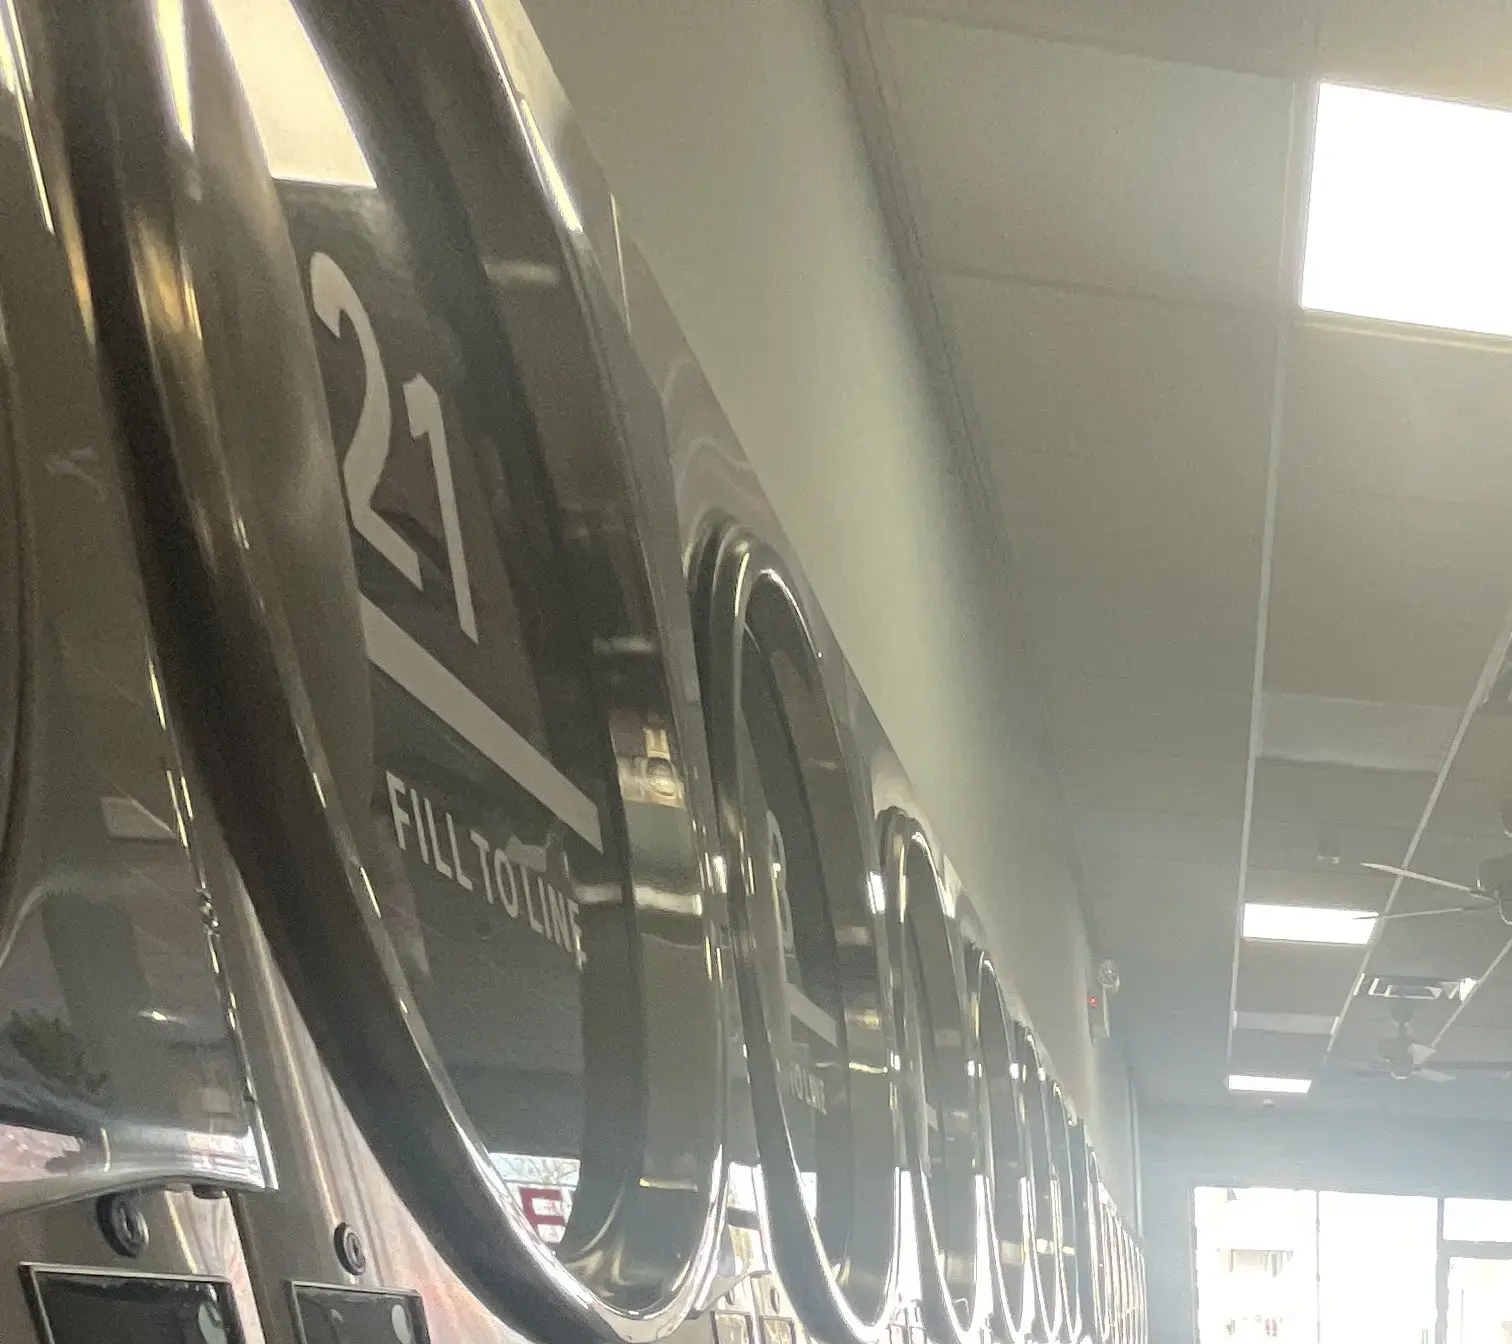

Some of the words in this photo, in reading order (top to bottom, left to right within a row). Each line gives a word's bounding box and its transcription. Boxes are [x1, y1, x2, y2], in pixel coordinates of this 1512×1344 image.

[310, 251, 479, 645] 21
[385, 770, 473, 891] FILL
[469, 829, 519, 919] TO
